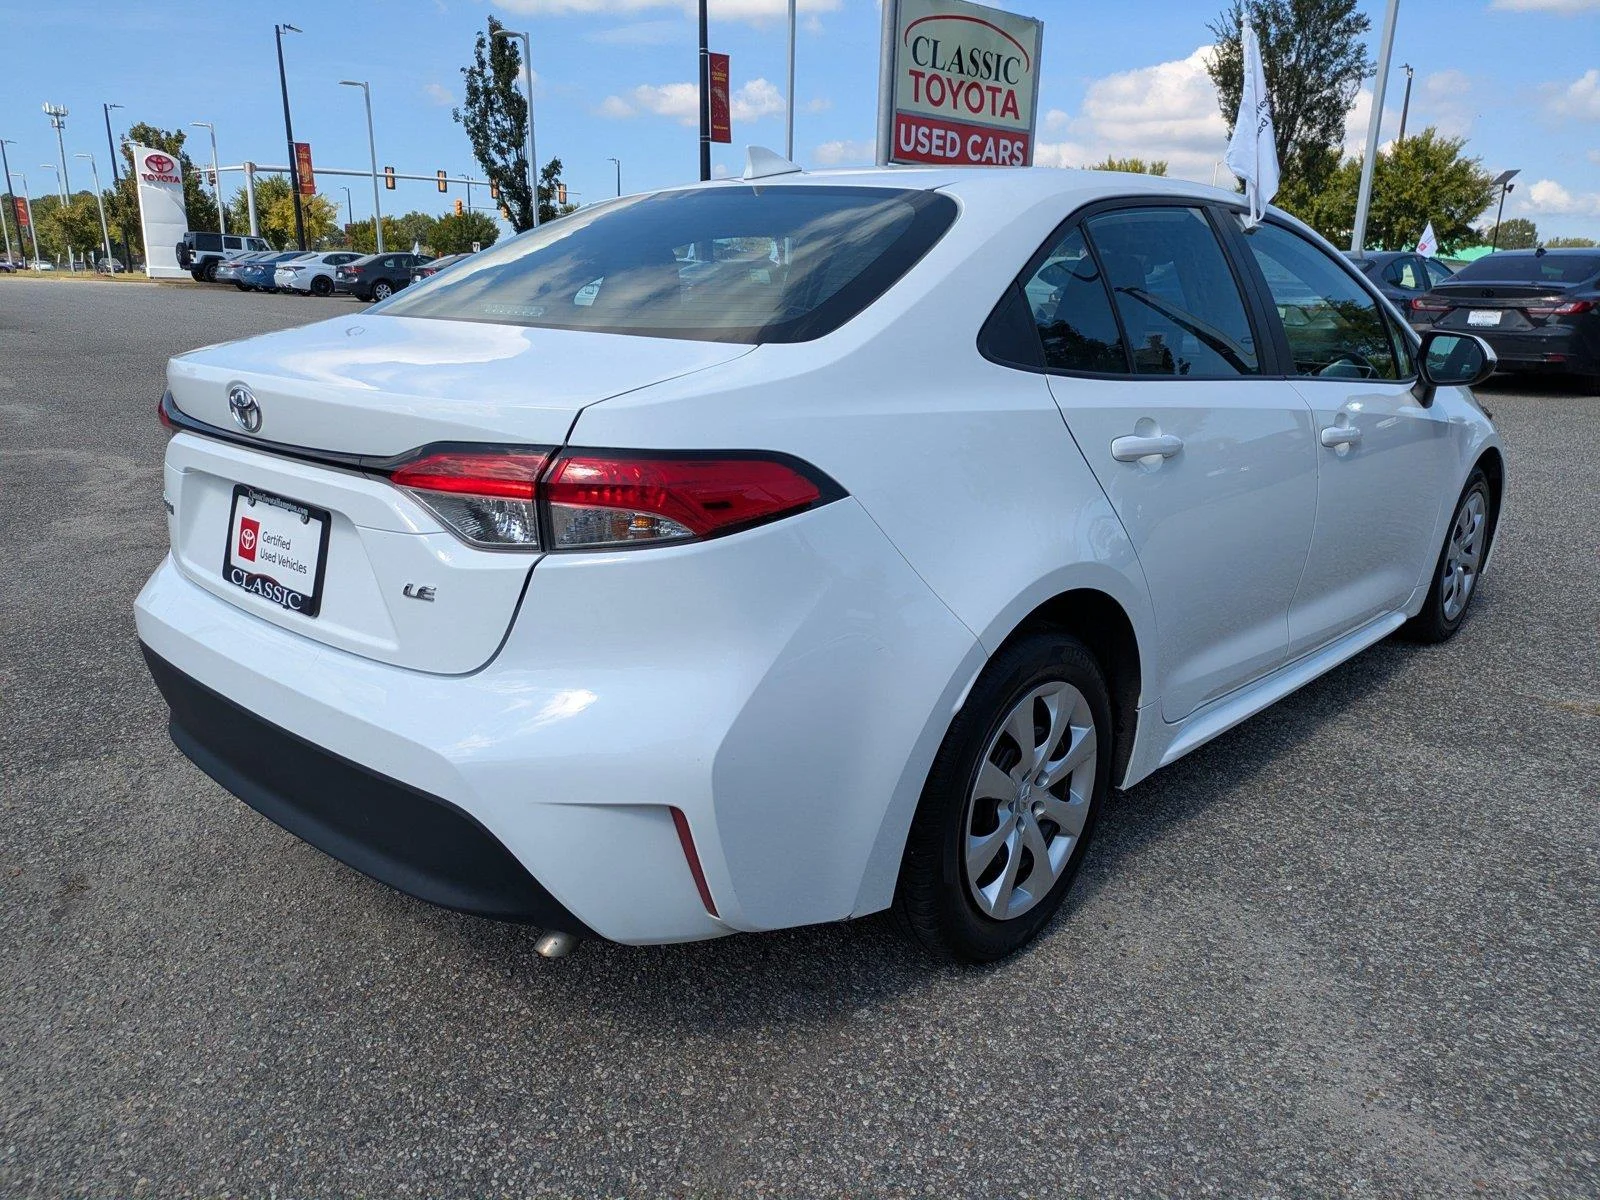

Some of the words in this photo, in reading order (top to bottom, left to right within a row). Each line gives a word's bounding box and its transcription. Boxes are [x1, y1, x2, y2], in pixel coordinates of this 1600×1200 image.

[912, 36, 1021, 85] CLASSIC
[908, 69, 1020, 120] TOYOTA
[899, 123, 961, 158] USED
[966, 134, 1024, 167] CARS
[141, 173, 181, 184] TOYOTA
[262, 531, 292, 551] Certified
[260, 547, 277, 564] Used
[278, 554, 308, 575] Vehicles
[230, 568, 302, 610] CLASSIC
[402, 583, 437, 602] LE
